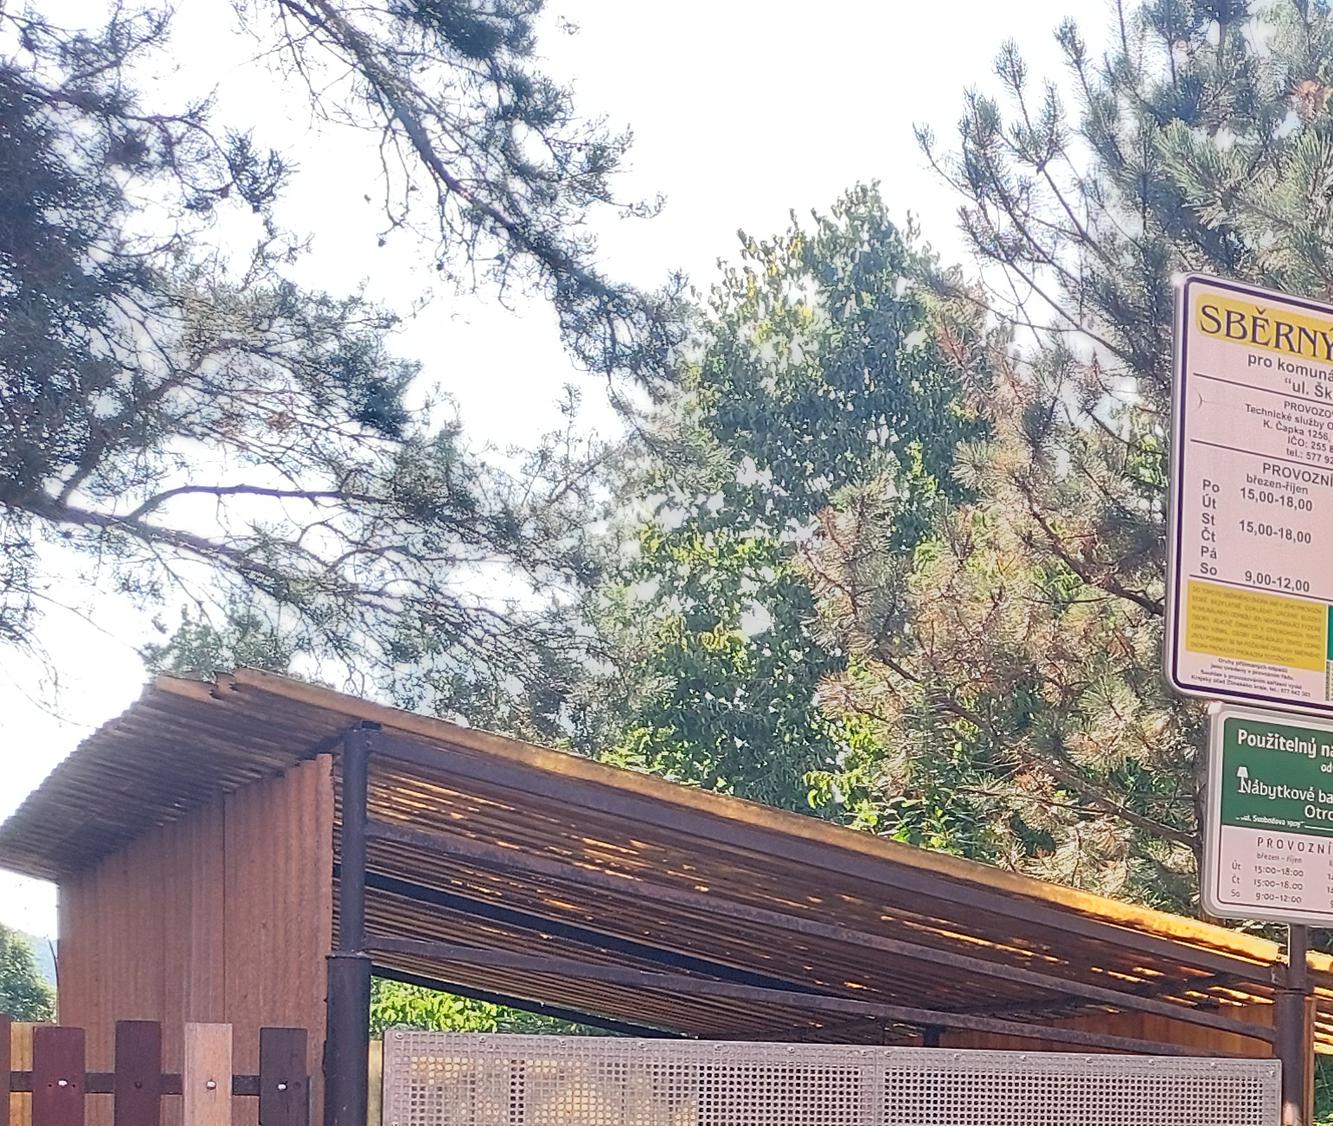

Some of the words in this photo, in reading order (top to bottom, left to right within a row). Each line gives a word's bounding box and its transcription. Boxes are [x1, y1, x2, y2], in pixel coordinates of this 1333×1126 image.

[1248, 354, 1272, 368] pro
[1245, 403, 1292, 422] Technické
[1295, 416, 1324, 430] služby
[1263, 419, 1272, 429] K.
[1275, 421, 1304, 436] Čapka
[1287, 436, 1308, 448] IČO:
[1311, 441, 1327, 452] 255
[1305, 452, 1322, 462] 577
[1246, 473, 1308, 495] březen-říjen
[1262, 462, 1333, 488] PROVOZNÍ
[1202, 479, 1220, 494] Po
[1240, 487, 1313, 512] 15,00-18,00
[1202, 491, 1217, 510] Út
[1201, 512, 1215, 527] St
[1239, 520, 1312, 544] 15,00-18,00
[1201, 525, 1216, 543] Čt
[1200, 545, 1217, 560] Pá
[1200, 562, 1218, 576] So
[1245, 569, 1310, 592] 9,00-12,00
[1237, 728, 1316, 758] Použitelný
[1240, 779, 1315, 802] Nábytkové
[1257, 836, 1332, 855] PROVOZNÍ
[1231, 860, 1241, 871] Út
[1254, 865, 1304, 877] 15:00-18:00
[1231, 874, 1240, 885] Čt
[1230, 889, 1240, 898] So
